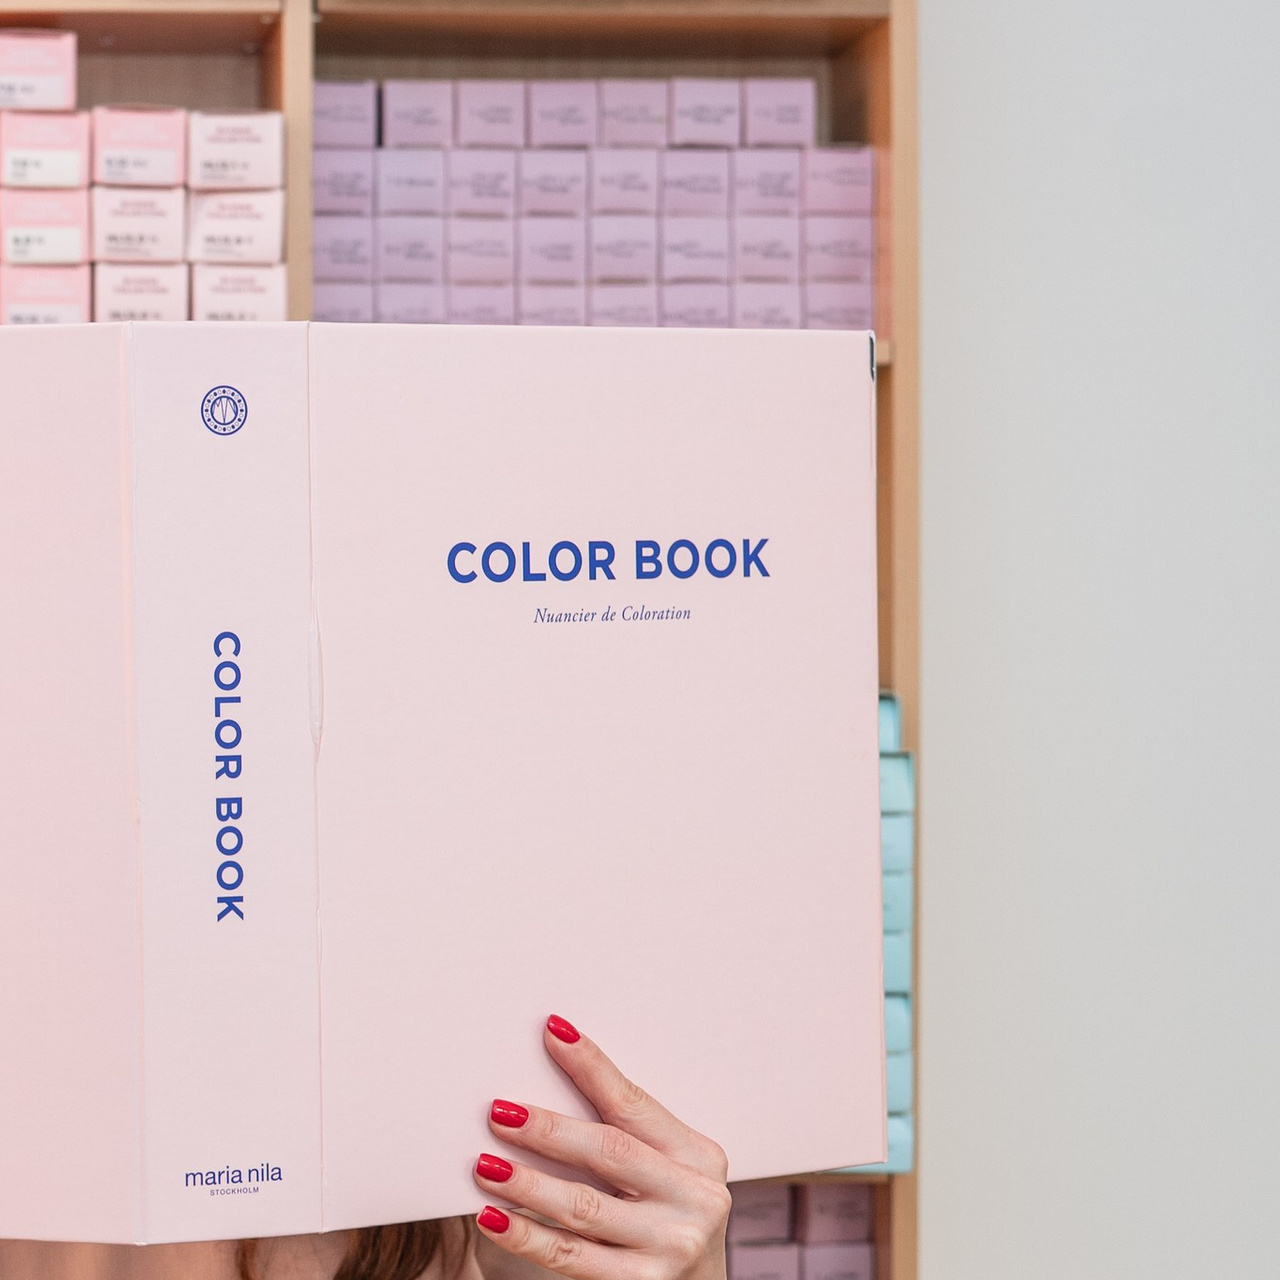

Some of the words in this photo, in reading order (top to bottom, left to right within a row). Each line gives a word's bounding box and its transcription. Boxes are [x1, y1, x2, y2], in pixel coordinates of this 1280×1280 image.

[446, 540, 616, 584] COLOR
[635, 538, 770, 579] BOOK
[534, 608, 597, 623] Nuancier
[601, 605, 616, 621] de
[621, 605, 690, 621] Coloration
[212, 631, 242, 780] COLOR
[216, 797, 244, 922] BOOK
[185, 1165, 243, 1187] maria
[248, 1163, 283, 1183] nila
[210, 1187, 259, 1196] STOCKHOLM
